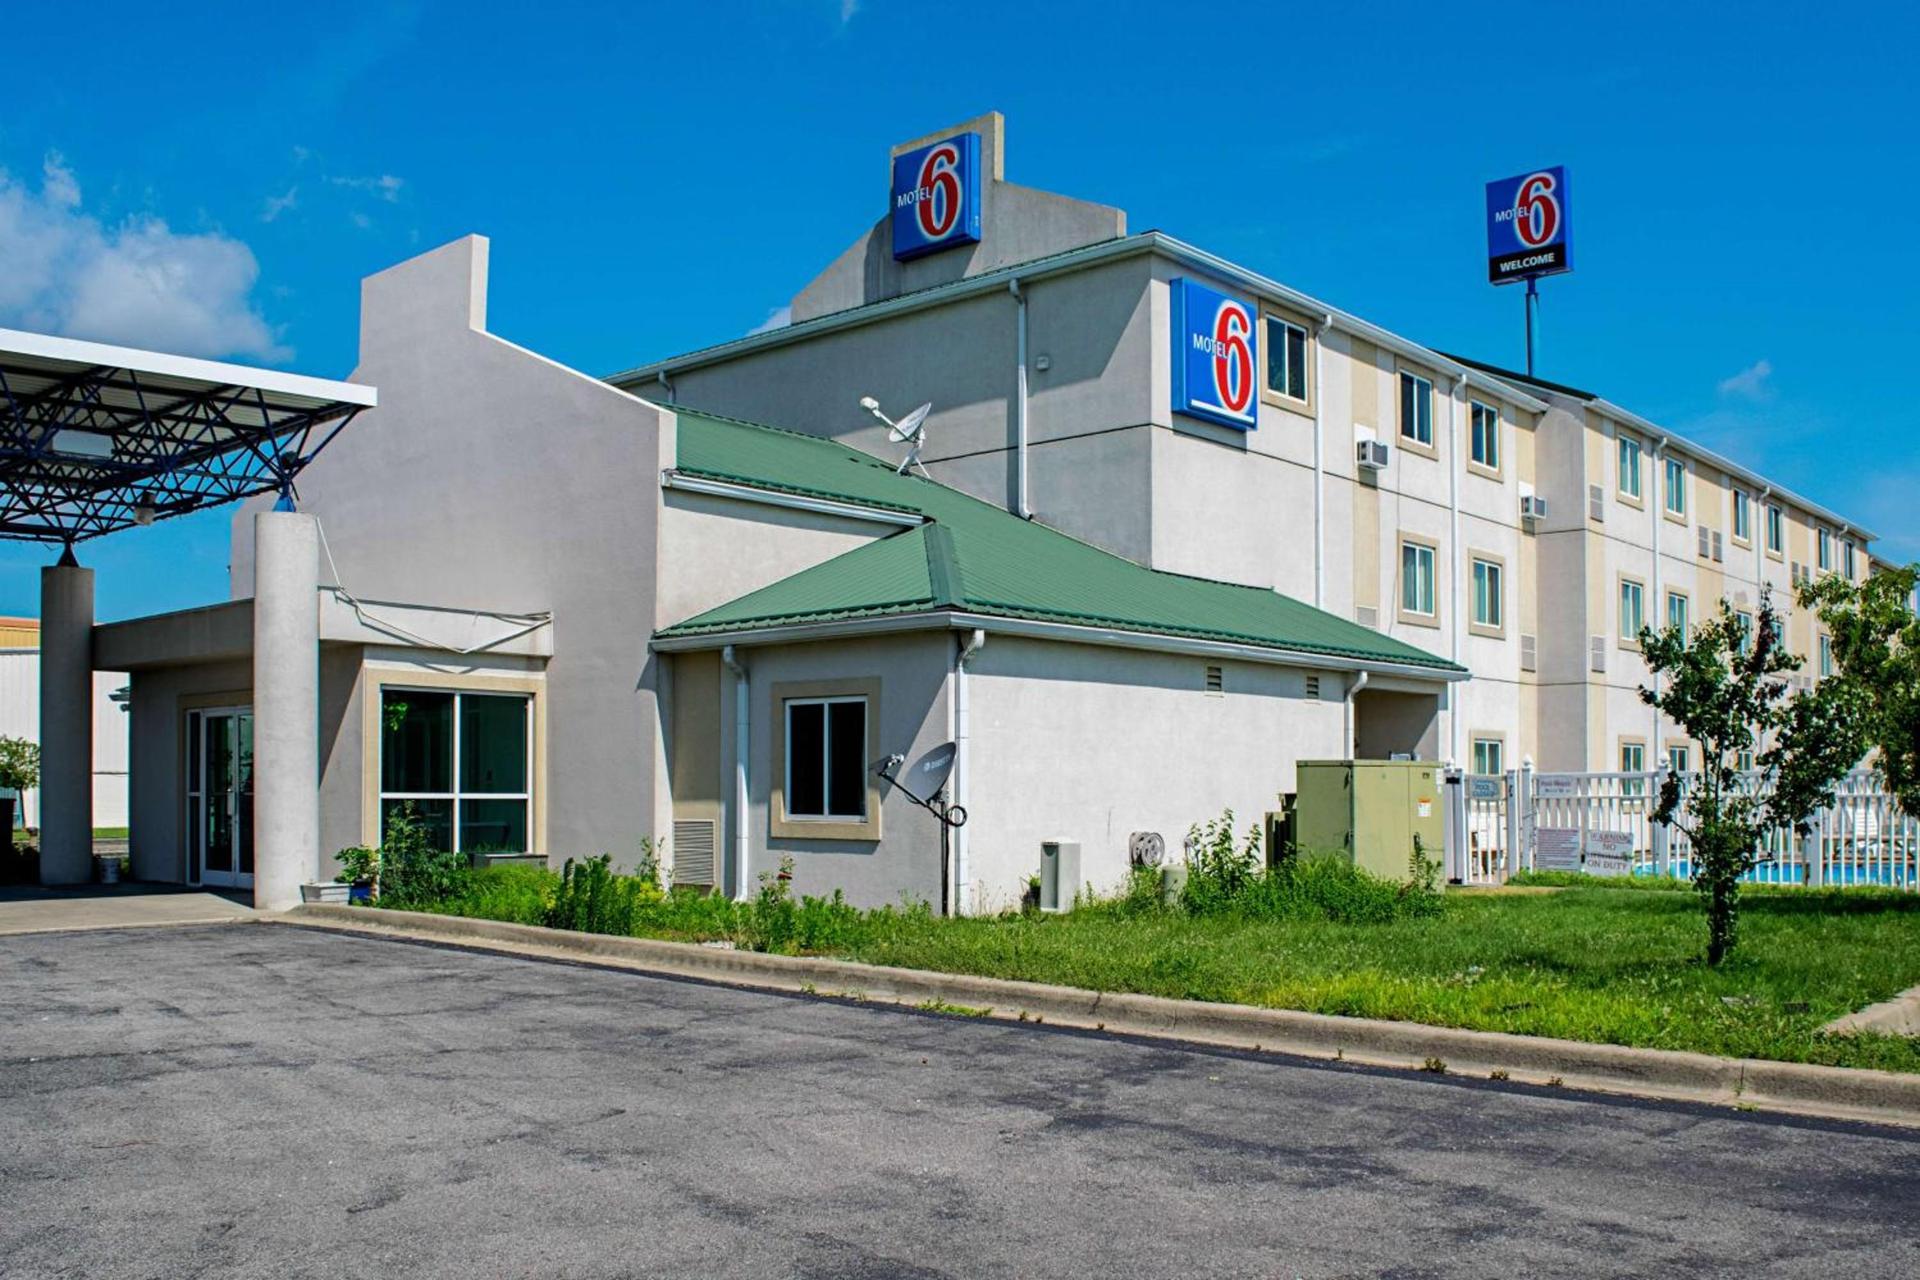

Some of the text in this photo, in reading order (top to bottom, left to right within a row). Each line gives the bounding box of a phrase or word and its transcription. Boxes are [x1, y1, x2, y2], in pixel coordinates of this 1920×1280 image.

[897, 143, 960, 239] MOTEL 6
[1495, 172, 1560, 248] MOTEL 6
[1499, 252, 1555, 272] WELCOME
[1192, 299, 1254, 415] MOTEL 6
[1587, 858, 1628, 871] ON DUTY
